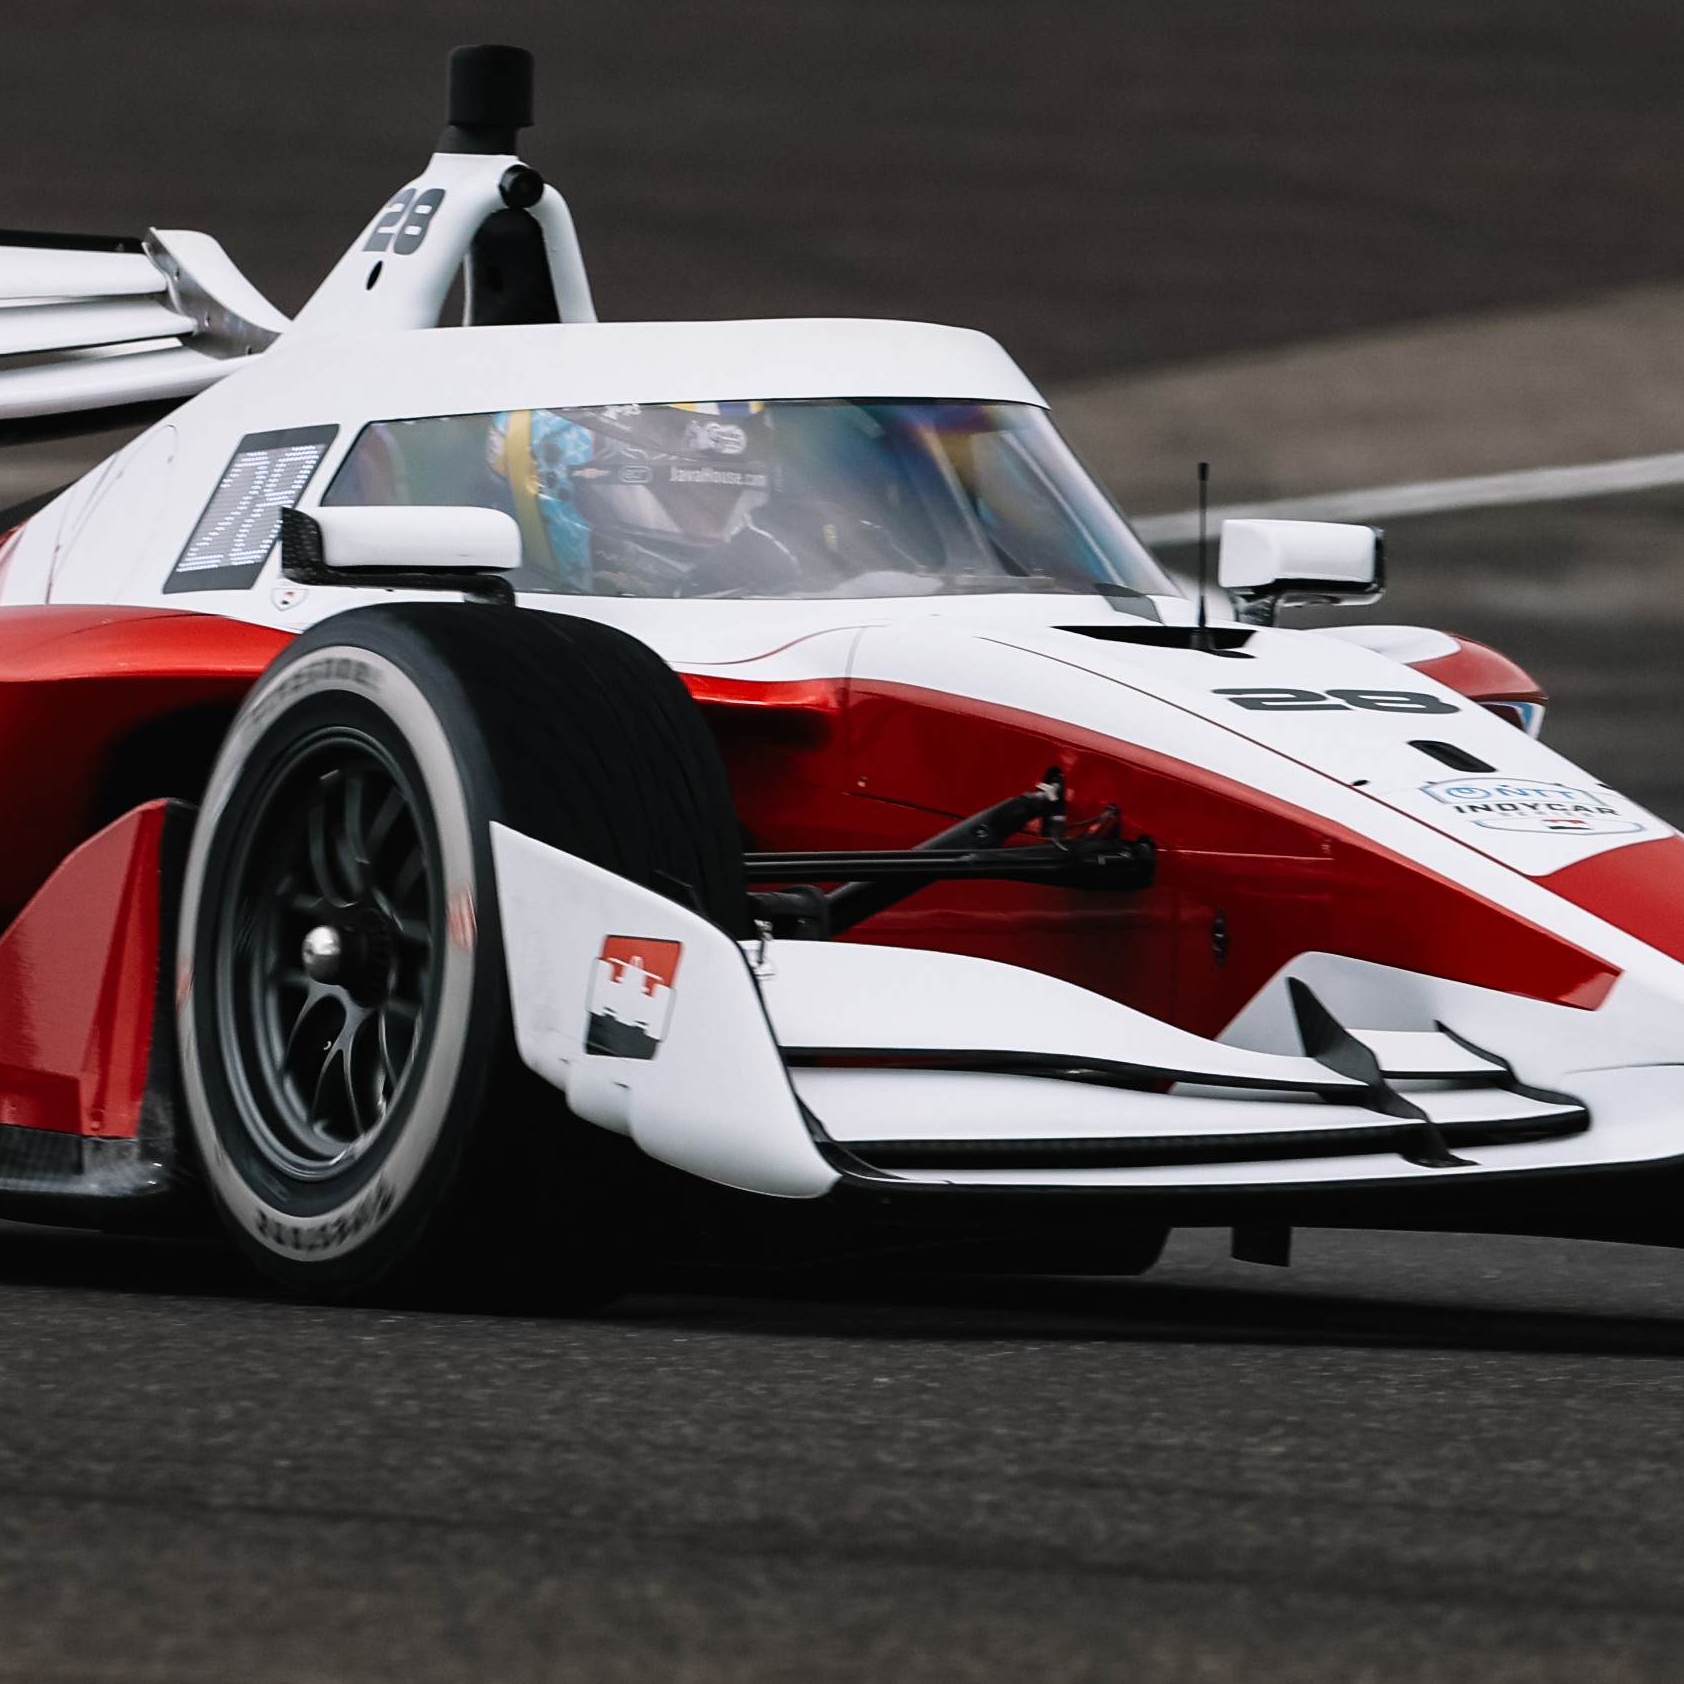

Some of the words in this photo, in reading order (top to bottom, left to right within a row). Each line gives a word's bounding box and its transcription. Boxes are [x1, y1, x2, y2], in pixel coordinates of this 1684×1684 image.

[362, 188, 446, 255] 28
[176, 444, 320, 572] 28
[1211, 688, 1461, 714] 28
[1496, 787, 1577, 800] NTT
[1453, 802, 1620, 816] INDYCAR
